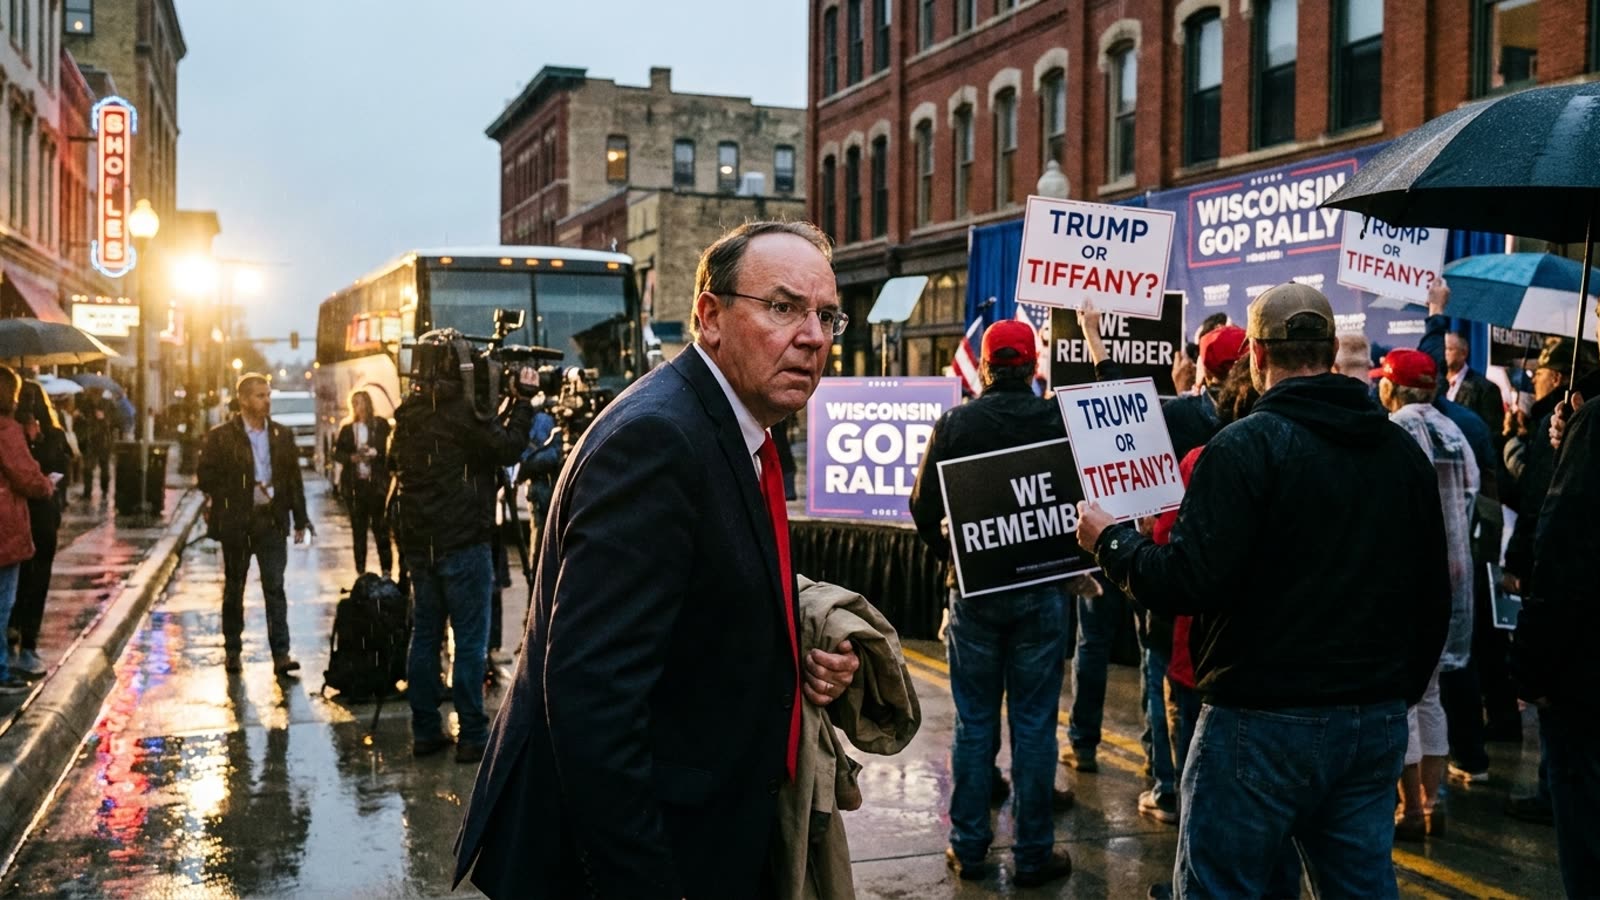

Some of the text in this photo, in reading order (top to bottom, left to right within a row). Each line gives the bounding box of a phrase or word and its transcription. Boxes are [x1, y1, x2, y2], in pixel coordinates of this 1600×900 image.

[1197, 172, 1345, 226] WISCONSIN
[1050, 209, 1149, 243] TRUMP
[1198, 208, 1342, 256] GOP RALLY
[1081, 245, 1108, 261] OR
[1382, 243, 1401, 258] OR
[1028, 258, 1159, 299] TIFFANY?
[1347, 250, 1435, 289] TIFFANY?
[1098, 313, 1130, 337] WE
[825, 402, 942, 421] WISCONSIN
[1077, 393, 1148, 429] TRUMP
[826, 422, 934, 465] GOP
[1115, 433, 1136, 452] OR
[1010, 471, 1056, 508] WE
[1084, 453, 1176, 498] TIFFANY?
